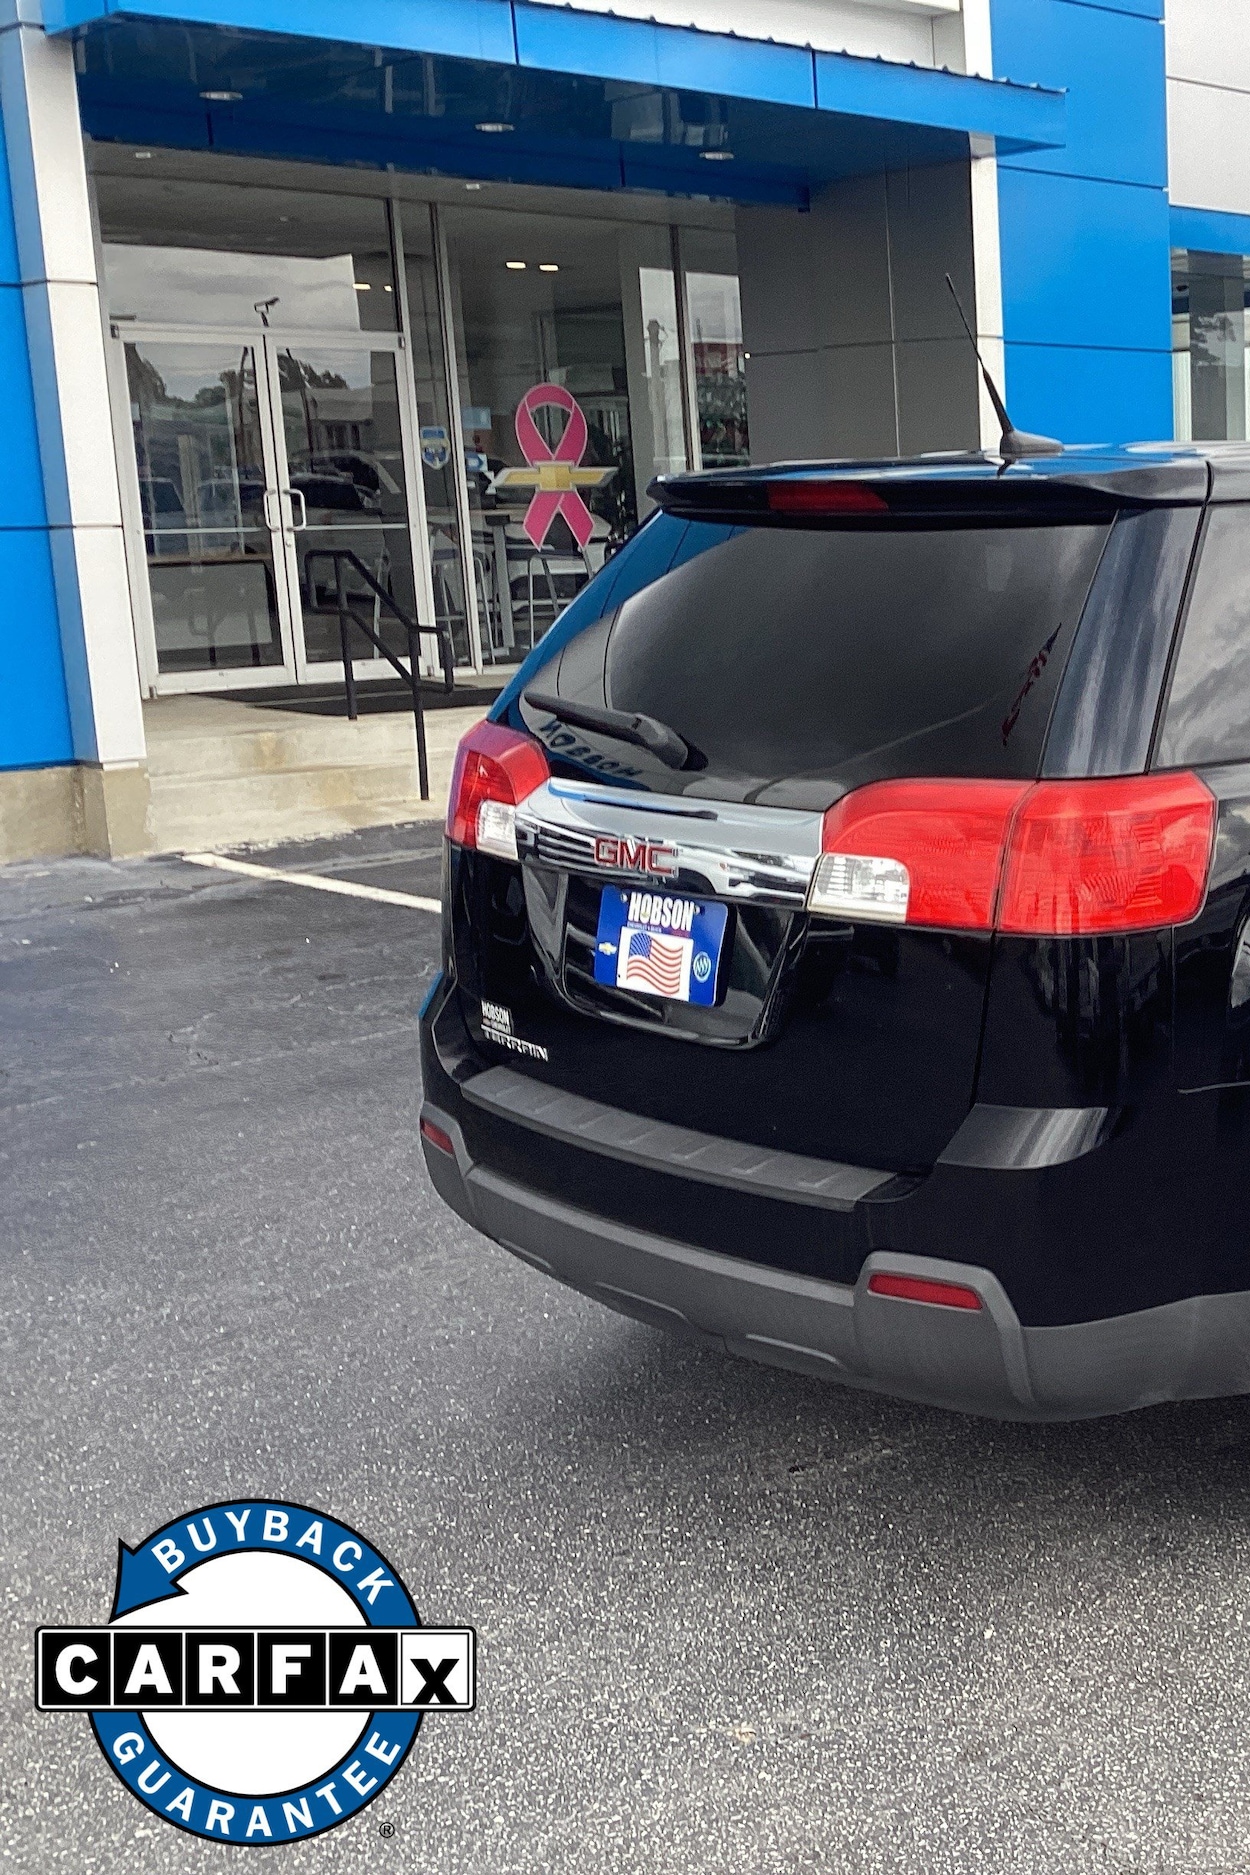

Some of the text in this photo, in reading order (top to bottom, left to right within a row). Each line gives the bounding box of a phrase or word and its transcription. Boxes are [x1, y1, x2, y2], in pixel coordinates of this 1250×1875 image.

[594, 834, 679, 879] GMC
[627, 891, 695, 932] HOBSON
[481, 999, 509, 1026] HOBSON
